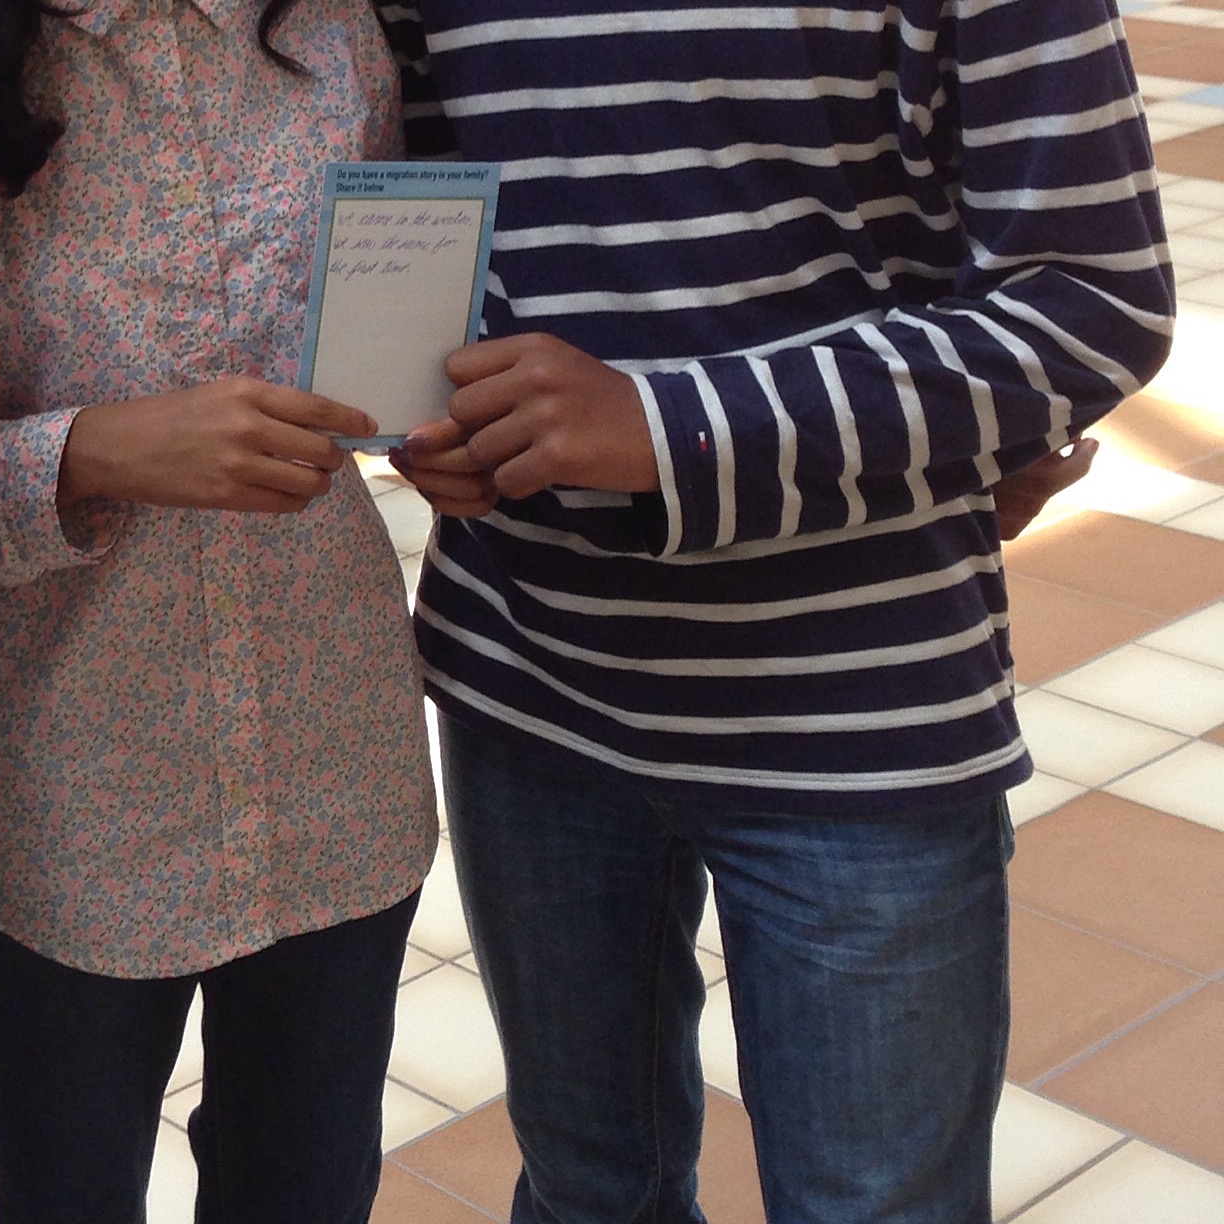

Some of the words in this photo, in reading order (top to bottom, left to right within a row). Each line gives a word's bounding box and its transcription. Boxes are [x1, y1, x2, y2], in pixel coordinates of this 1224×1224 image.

[336, 169, 347, 179] Do
[348, 170, 361, 181] you
[362, 169, 379, 179] have
[380, 171, 385, 179] a
[386, 169, 418, 182] migration
[420, 169, 437, 181] story
[438, 170, 445, 179] in
[447, 171, 462, 181] your
[464, 169, 489, 181] family?
[335, 183, 356, 193] Share
[357, 183, 363, 192] it
[412, 210, 432, 225] the
[380, 236, 400, 249] the
[329, 258, 347, 274] the
